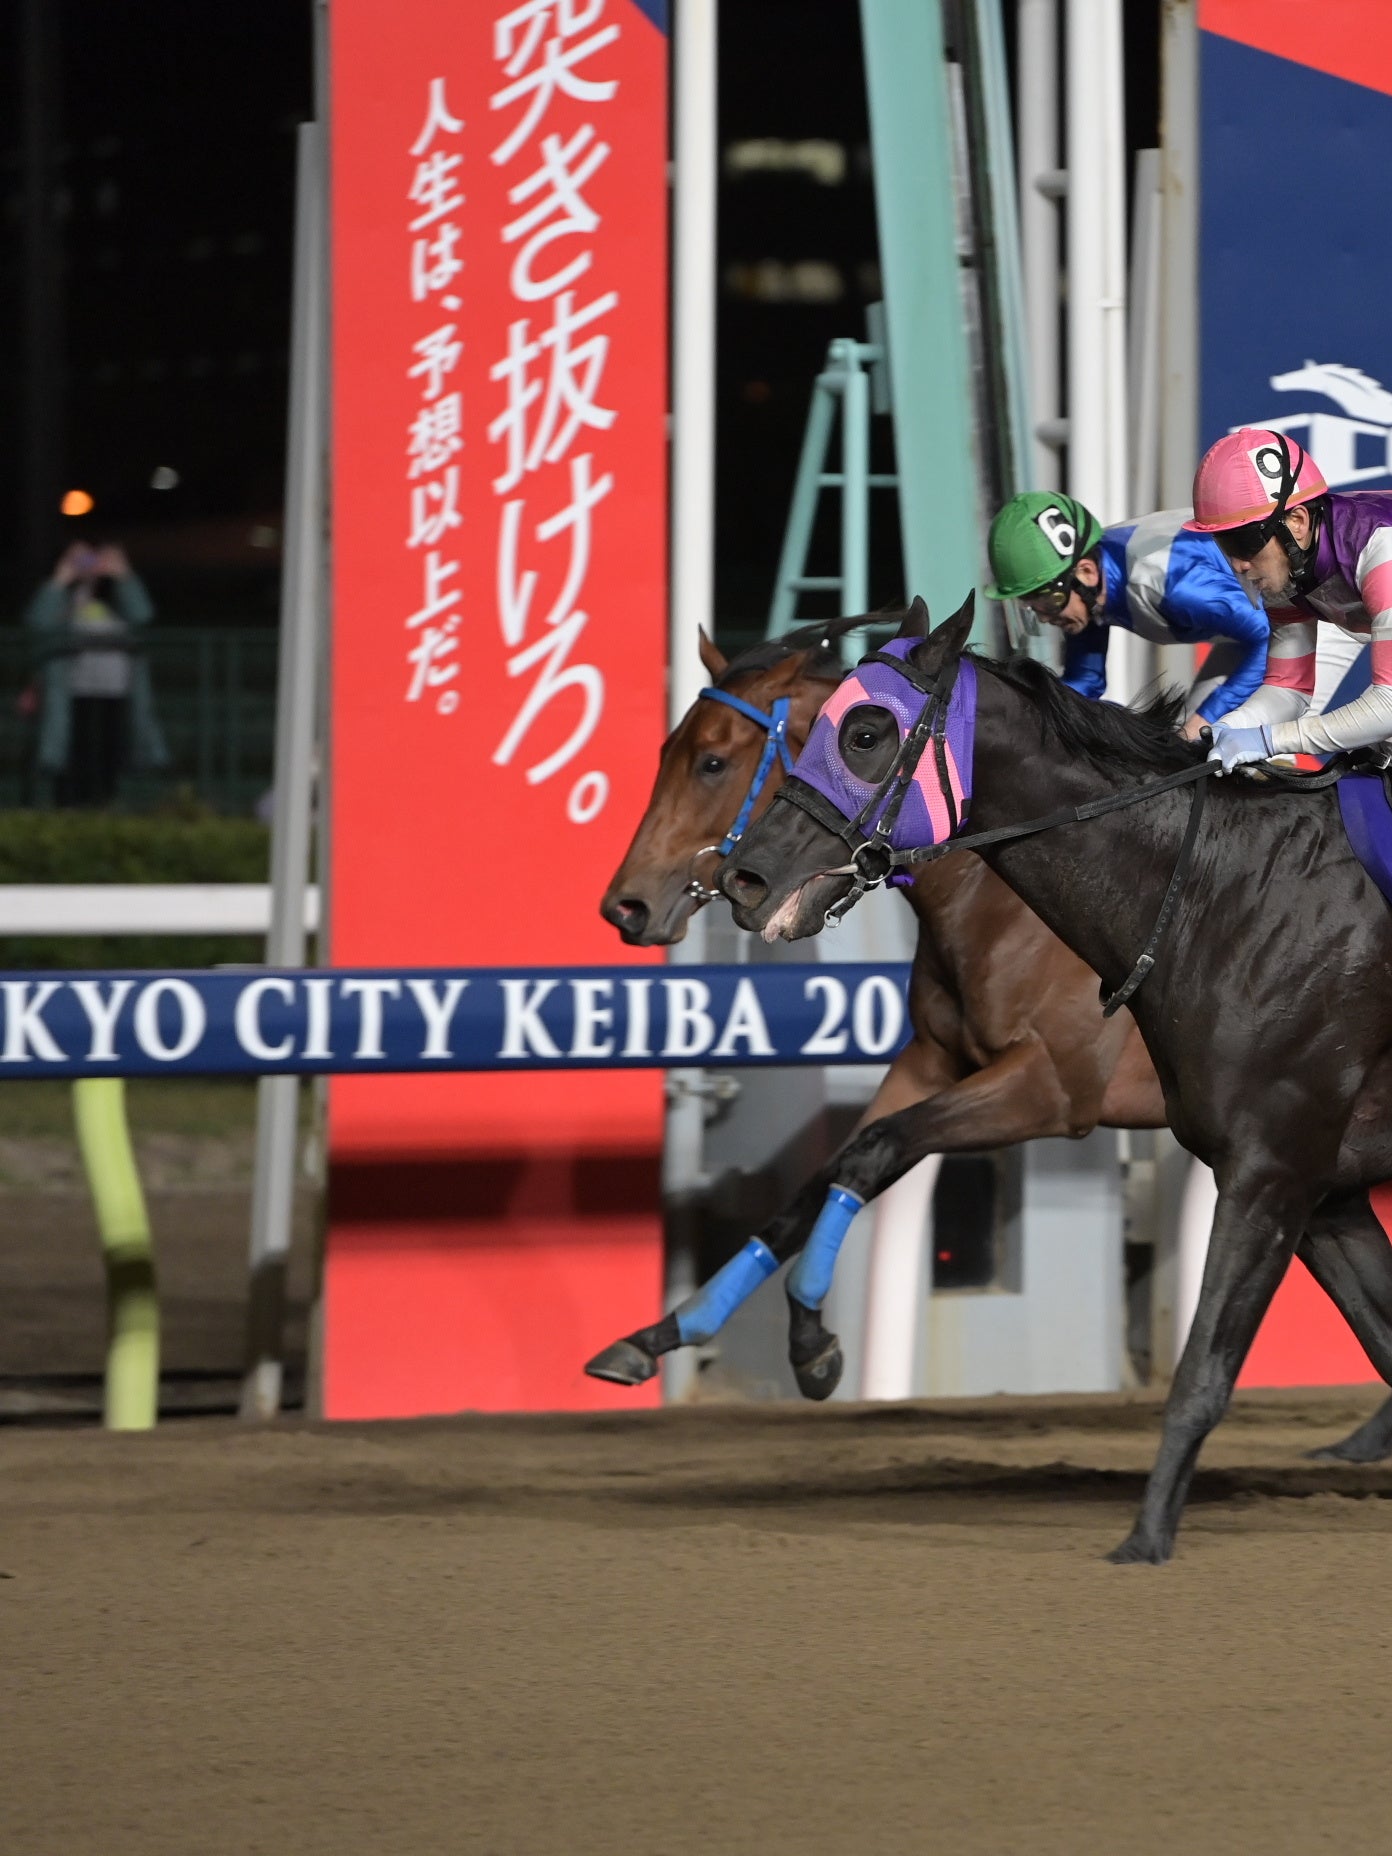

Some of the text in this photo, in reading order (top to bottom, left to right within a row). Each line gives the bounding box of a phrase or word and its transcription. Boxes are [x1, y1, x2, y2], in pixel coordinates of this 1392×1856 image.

[406, 78, 464, 715] 人生は、予想以上だ。
[488, 0, 620, 824] 突き抜けろ。
[1043, 508, 1077, 556] 6
[0, 974, 909, 1062] KYO CITY KEIBA 20
